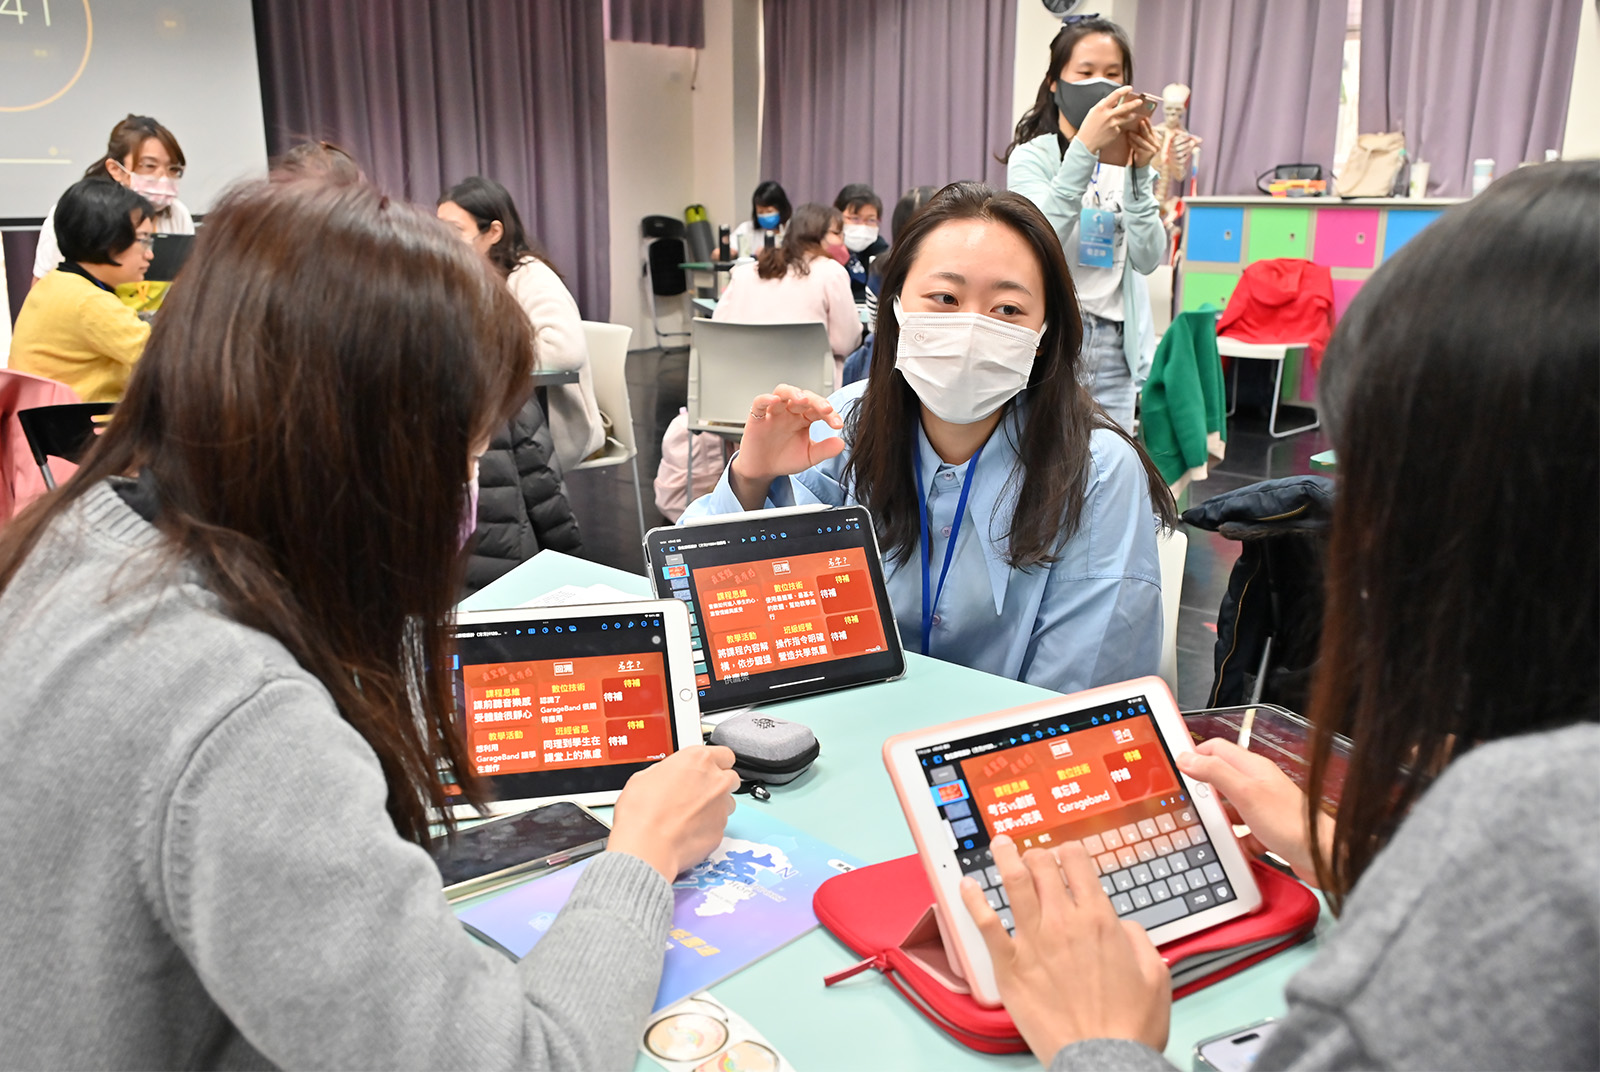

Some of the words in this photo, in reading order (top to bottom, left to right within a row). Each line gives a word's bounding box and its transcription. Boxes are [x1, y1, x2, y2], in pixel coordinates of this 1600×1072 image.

[835, 574, 850, 584] 待補
[773, 581, 804, 593] 數位技術
[716, 589, 748, 601] 課程思維
[820, 588, 837, 599] 待補
[768, 613, 776, 621] 行
[844, 614, 860, 625] 待補
[783, 622, 813, 634] 班級經營
[726, 631, 757, 644] 教學活動
[775, 633, 825, 649] 操作指令明確
[830, 630, 848, 641] 待補
[717, 642, 769, 659] 將課程內容解
[778, 645, 828, 662] 營造共學氛圍
[720, 654, 772, 672] 構，依步驟提
[551, 682, 586, 693] 數位技術
[623, 678, 641, 688] 待補
[485, 687, 520, 699] 課程思維
[603, 691, 623, 702] 待補
[473, 696, 532, 711] 課前聽音樂感
[539, 695, 561, 705] 認識了
[540, 703, 581, 714] GarageBand
[474, 709, 533, 723] 受體驗很靜心
[541, 714, 563, 724] 待應用
[555, 724, 590, 736] 班經省思
[627, 720, 645, 730] 待補
[488, 730, 524, 742] 教學活動
[608, 735, 628, 747] 待補
[475, 743, 499, 753] 想利用
[543, 736, 601, 750] 同理到學生在
[476, 752, 520, 763] GarageBand
[544, 748, 602, 763] 課堂上的焦慮
[1123, 749, 1142, 763] 待補
[476, 764, 500, 774] 生創作
[1056, 763, 1092, 781] 數位技術
[1110, 767, 1132, 783] 待補
[993, 779, 1030, 798] 課程思維
[1057, 789, 1111, 814] Garageband
